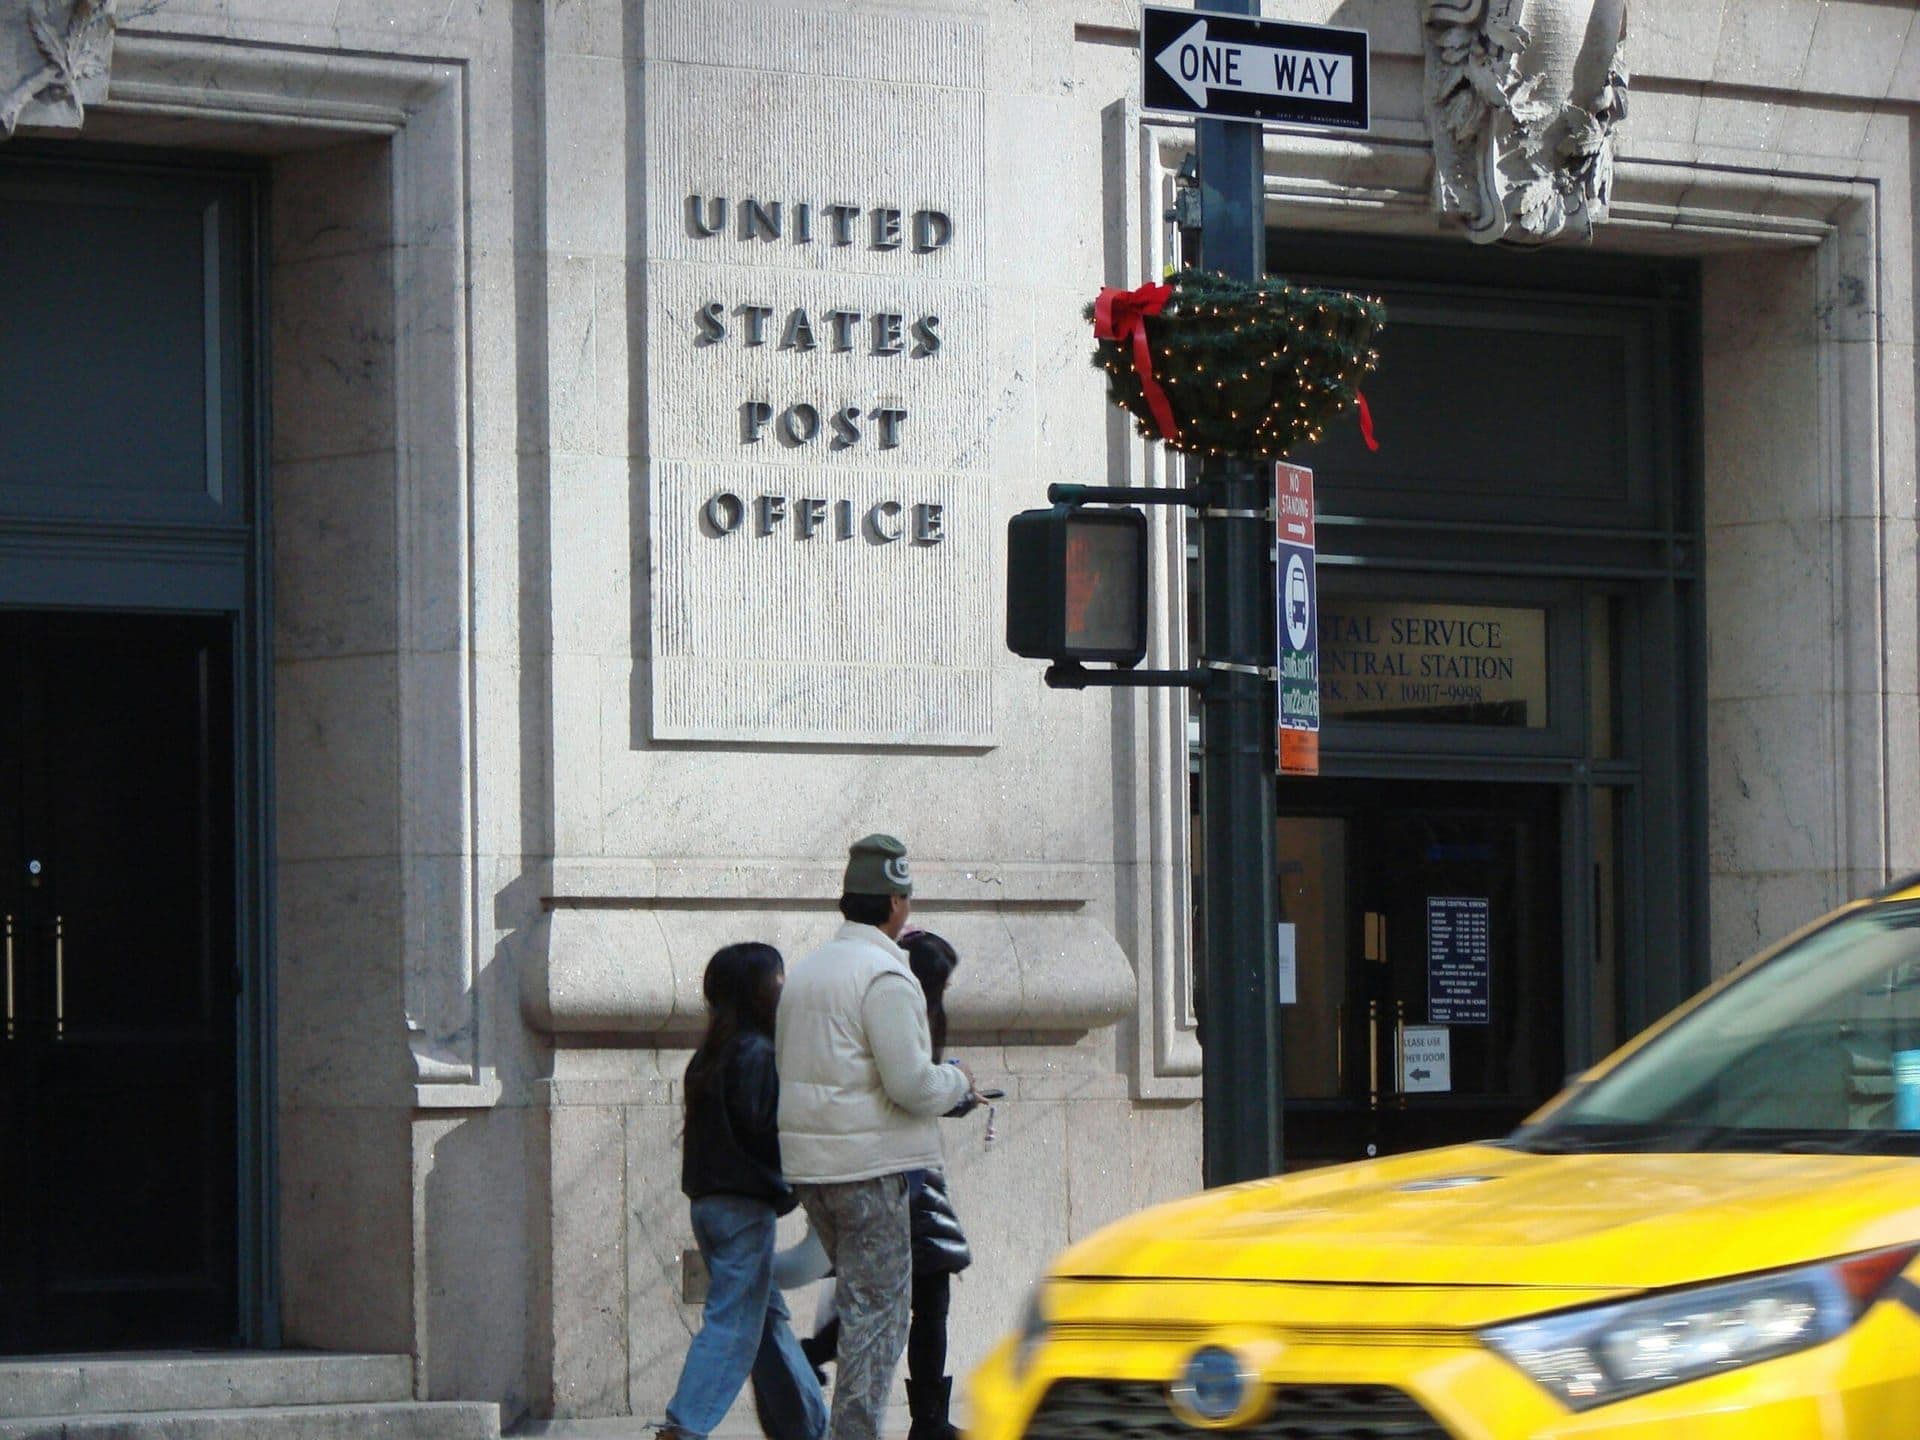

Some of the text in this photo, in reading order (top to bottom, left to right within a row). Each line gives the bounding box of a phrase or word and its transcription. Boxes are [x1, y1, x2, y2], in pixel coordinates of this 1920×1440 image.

[1180, 43, 1339, 96] ONE WAY
[686, 194, 953, 254] UNITED
[695, 302, 941, 359] STATES
[740, 400, 907, 449] POST
[1289, 471, 1300, 493] NO
[701, 492, 944, 547] OFFICE
[1281, 494, 1309, 518] STANDING
[1391, 617, 1502, 649] SERVICE
[1420, 653, 1513, 680] STATION
[1423, 1051, 1446, 1063] DOOR
